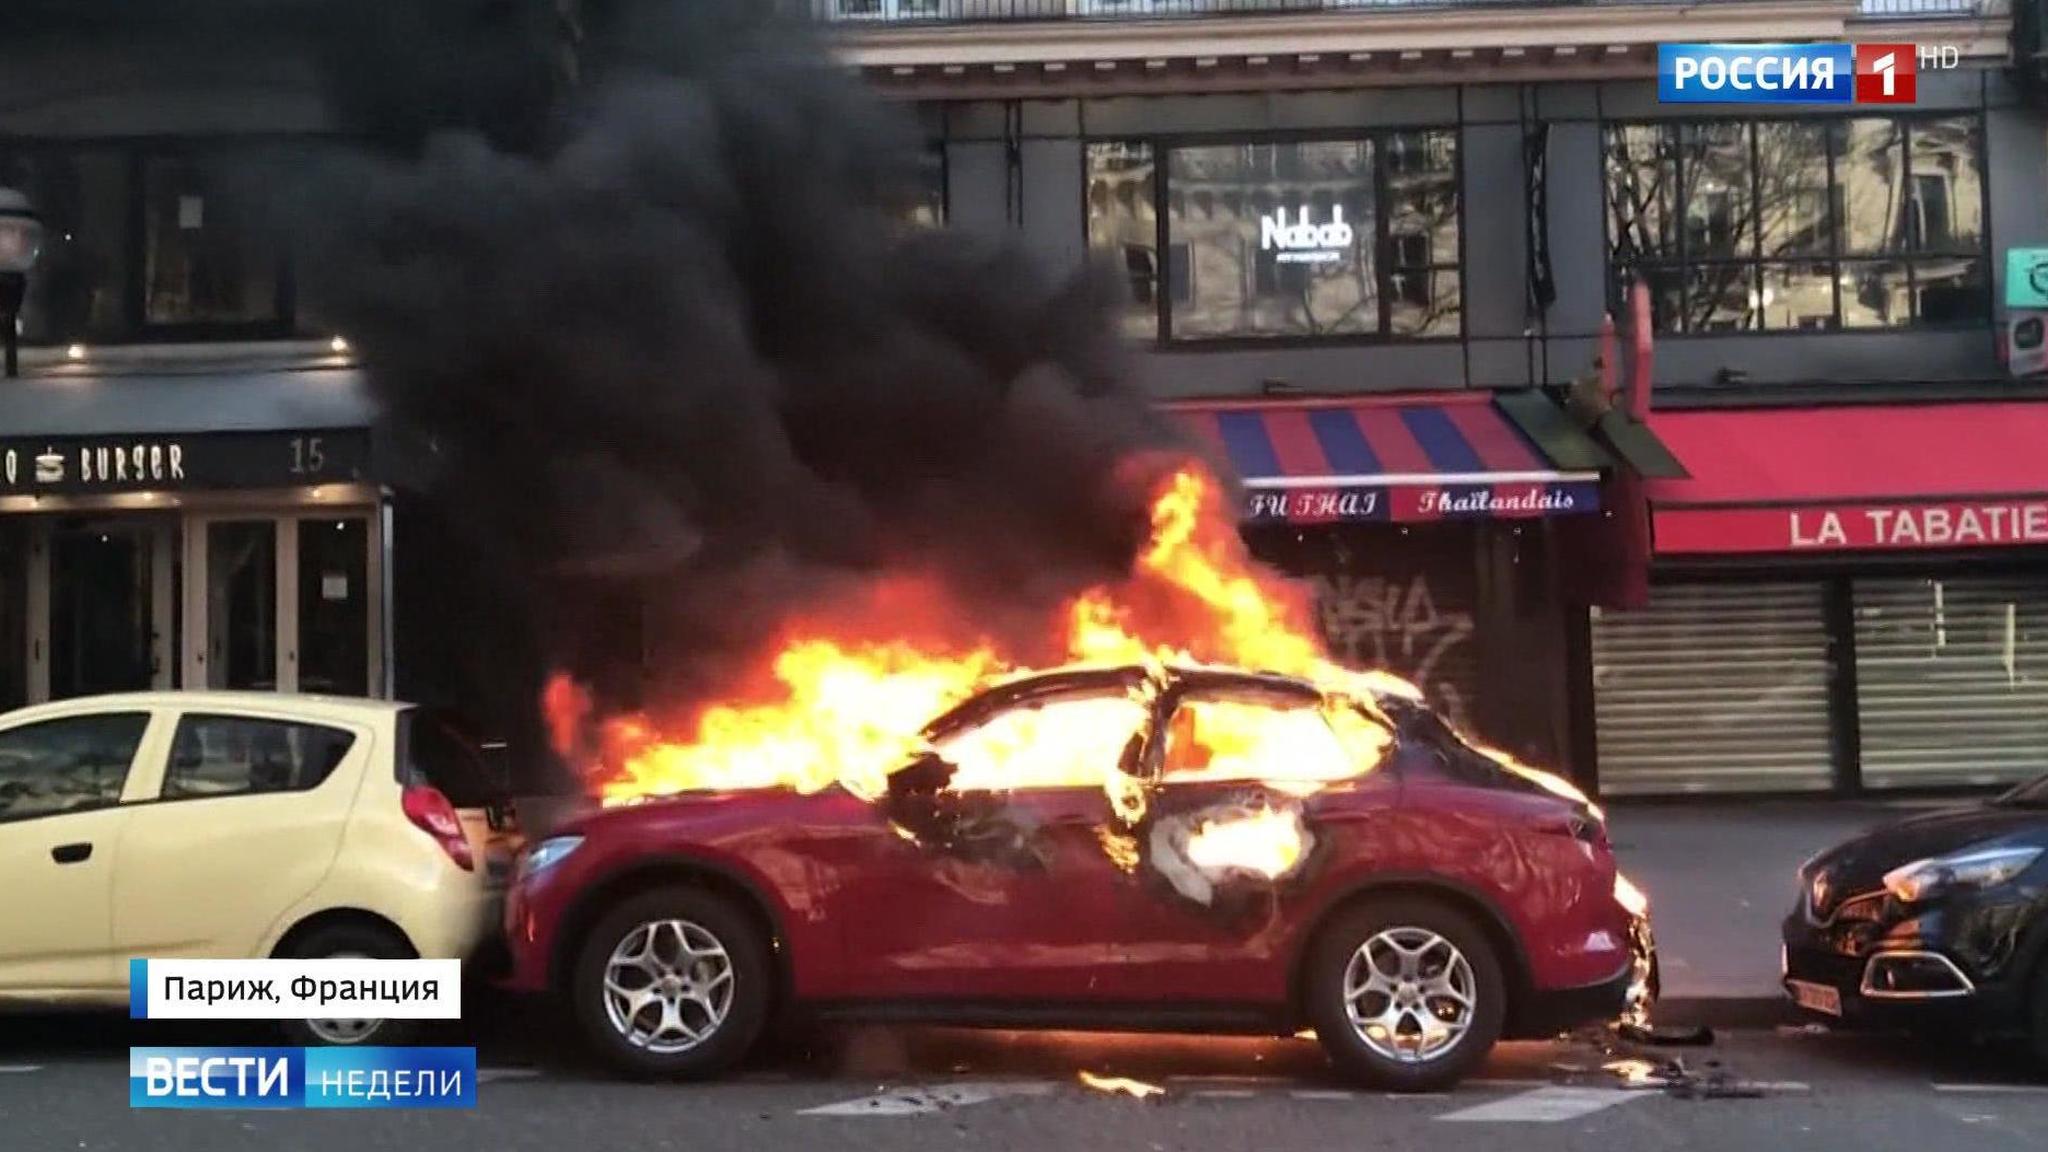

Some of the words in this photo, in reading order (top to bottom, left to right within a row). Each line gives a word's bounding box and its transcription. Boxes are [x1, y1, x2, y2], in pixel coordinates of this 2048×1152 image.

[1261, 203, 1353, 250] Nabab
[289, 437, 324, 475] 15
[1789, 511, 1847, 546] LA
[1865, 504, 2048, 545] TABATIE
